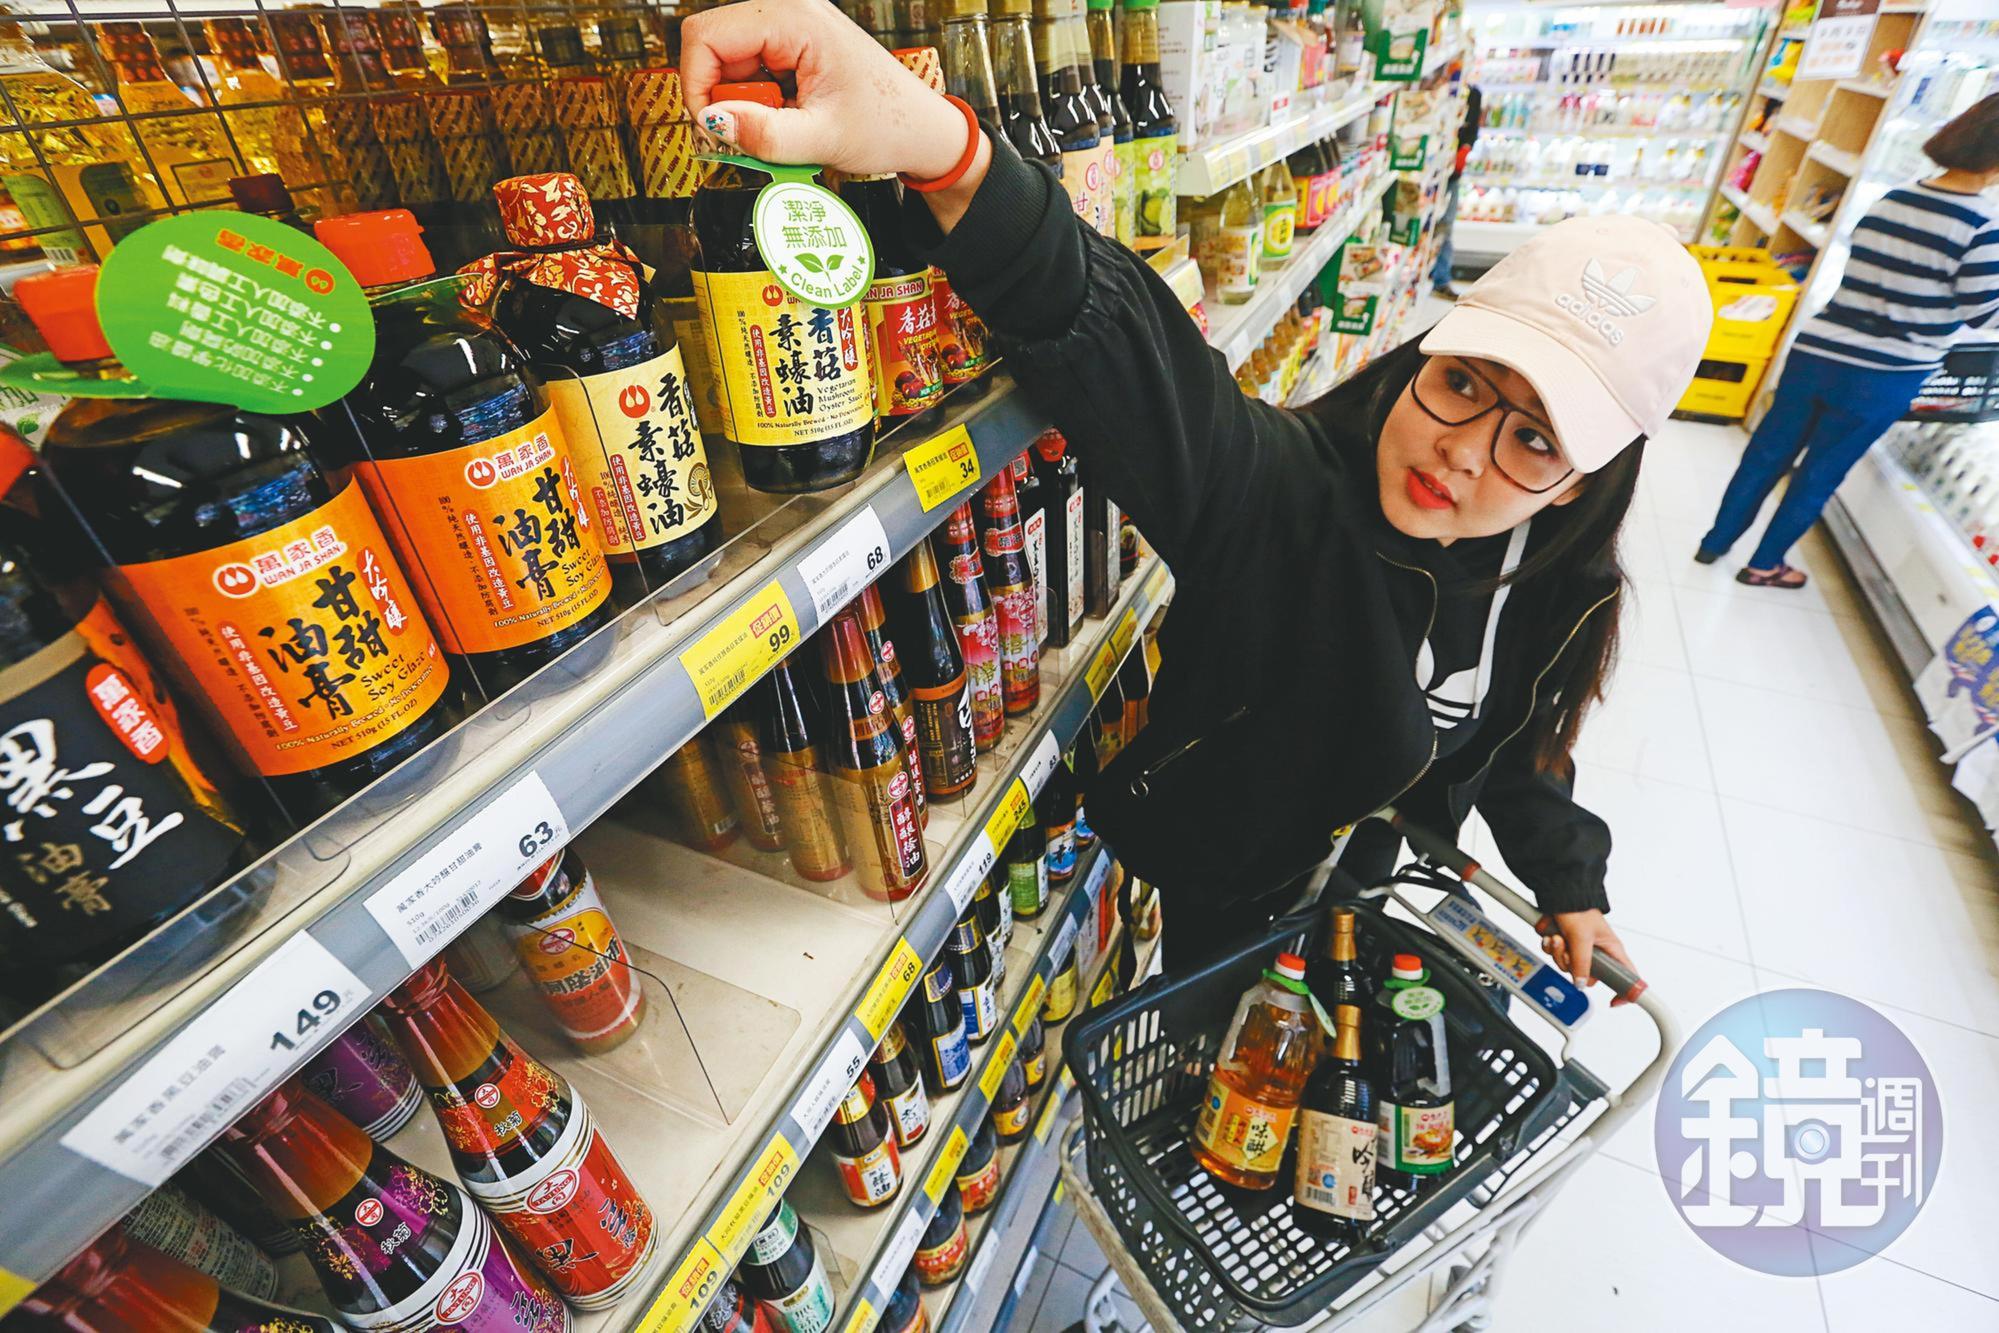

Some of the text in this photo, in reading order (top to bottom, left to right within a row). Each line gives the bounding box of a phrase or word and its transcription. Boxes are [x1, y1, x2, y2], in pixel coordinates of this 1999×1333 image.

[782, 200, 826, 222] 潔淨
[782, 226, 847, 248] 無添加
[791, 272, 832, 299] Clean
[836, 264, 863, 298] Label
[880, 286, 894, 298] JA
[897, 282, 924, 296] SHAN
[1555, 294, 1623, 347] adidas
[807, 308, 842, 381] 香菇
[769, 314, 815, 418] 素蠔油
[657, 372, 696, 462] 香菇
[819, 399, 847, 413] Oyster
[793, 428, 810, 437] NET
[810, 426, 825, 436] 510g
[496, 434, 549, 468] 萬家香
[501, 450, 552, 480] WAN JA SHAN
[628, 420, 685, 535] 素蠔油
[960, 459, 975, 479] 34
[532, 467, 582, 559] 甘甜
[255, 527, 337, 575] 萬家香
[264, 544, 342, 586] WAN JA SHAN
[465, 512, 515, 610] 使用非基因改造黃豆
[491, 508, 559, 601] 油膏
[562, 549, 592, 576] Sweet
[866, 546, 884, 570] 68
[566, 572, 586, 588] Soy
[312, 565, 390, 671] 甘甜
[493, 615, 518, 628] 100%
[519, 605, 552, 622] Naturally
[537, 616, 555, 628] NET
[555, 608, 571, 623] 510g
[769, 624, 791, 653] 99
[258, 617, 358, 722] 油膏
[360, 653, 406, 689] Sweet
[367, 679, 397, 702] Soy
[275, 737, 306, 751] 100%
[306, 724, 350, 748] Naturally
[330, 734, 355, 750] NET
[355, 723, 378, 744] 510g
[0, 717, 185, 871] 黑豆
[1013, 801, 1027, 822] 245
[518, 821, 554, 858] 63
[397, 842, 483, 914] 萬家香大吟釀甘甜油膏
[978, 853, 993, 875] 119
[902, 961, 916, 983] 68
[270, 989, 341, 1052] 149
[846, 1056, 861, 1079] 55
[114, 1044, 227, 1145] 萬家香黑豆油膏
[493, 1110, 523, 1137] 秋菊
[764, 1163, 791, 1199] 109
[380, 1221, 412, 1254] 秋菊
[679, 1257, 710, 1300] 促銷價
[688, 1269, 719, 1313] 109
